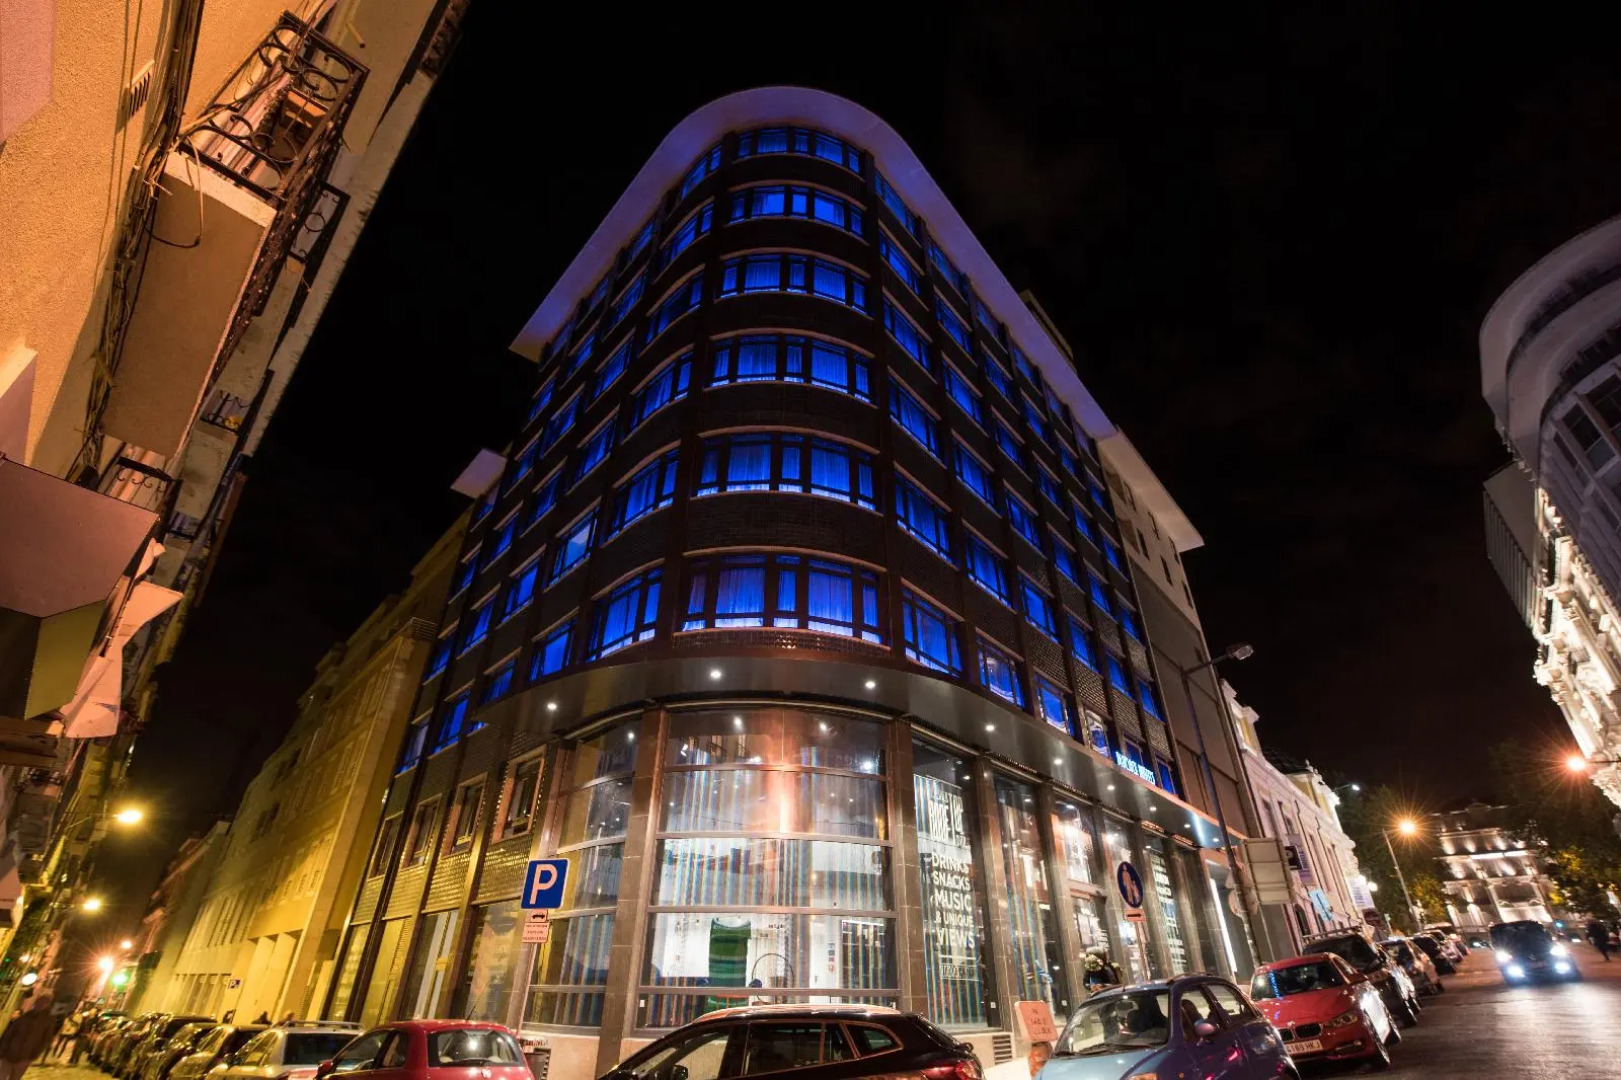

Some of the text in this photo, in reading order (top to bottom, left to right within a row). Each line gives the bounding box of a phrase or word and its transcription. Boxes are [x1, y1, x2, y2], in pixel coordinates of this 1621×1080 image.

[932, 852, 970, 874] DRINKS
[529, 864, 558, 905] P
[932, 870, 971, 892] SNACKS
[934, 887, 973, 912] MUSIC
[935, 910, 975, 928] & UNIQUE
[936, 926, 976, 949] VIEWS
